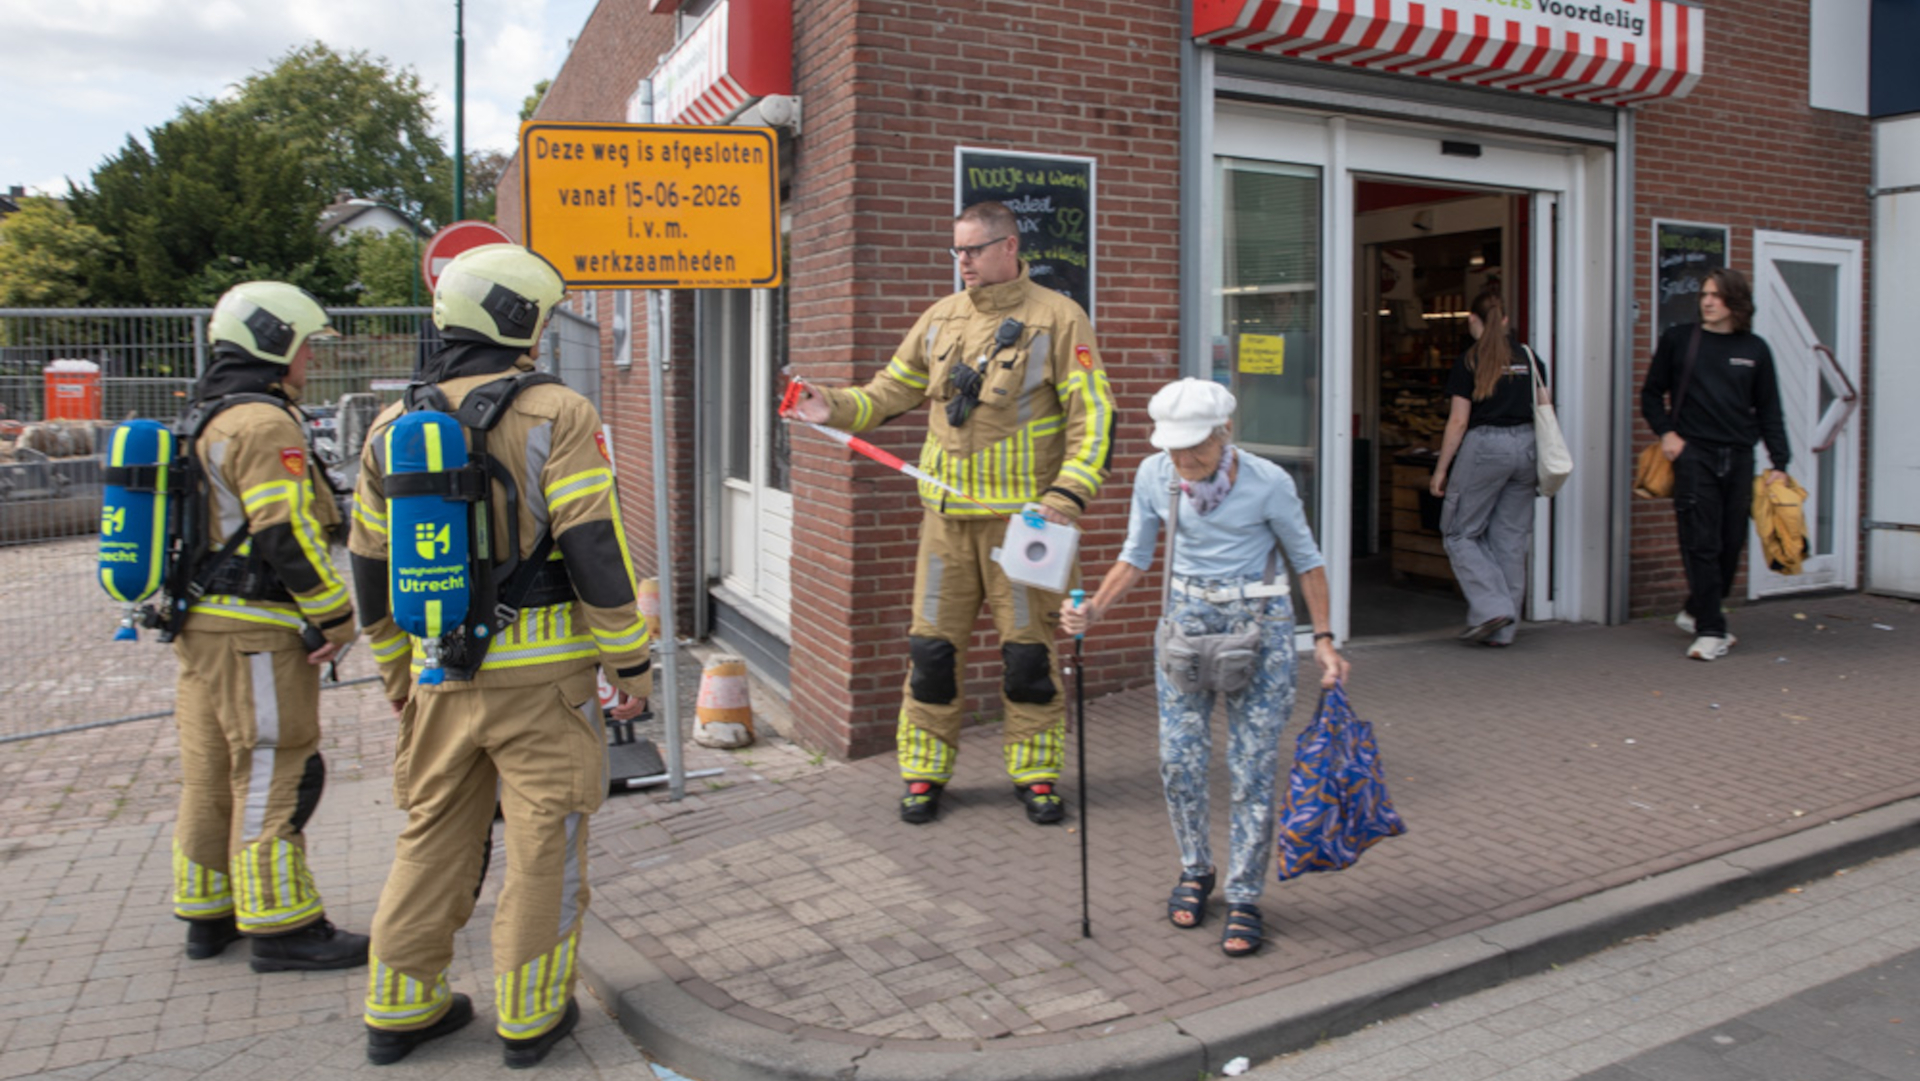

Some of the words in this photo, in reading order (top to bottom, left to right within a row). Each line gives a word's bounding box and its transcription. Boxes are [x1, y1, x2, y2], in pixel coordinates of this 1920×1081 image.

[1537, 0, 1645, 36] Voordelig
[536, 137, 585, 160] Deze
[592, 142, 629, 167] weg
[637, 140, 654, 162] is
[661, 141, 763, 168] afgesloten
[558, 184, 616, 206] vanaf
[625, 182, 740, 207] 15-06-2026
[627, 217, 688, 238] i.v.m.
[574, 251, 735, 272] werkzaamheden
[399, 575, 465, 592] Utrecht
